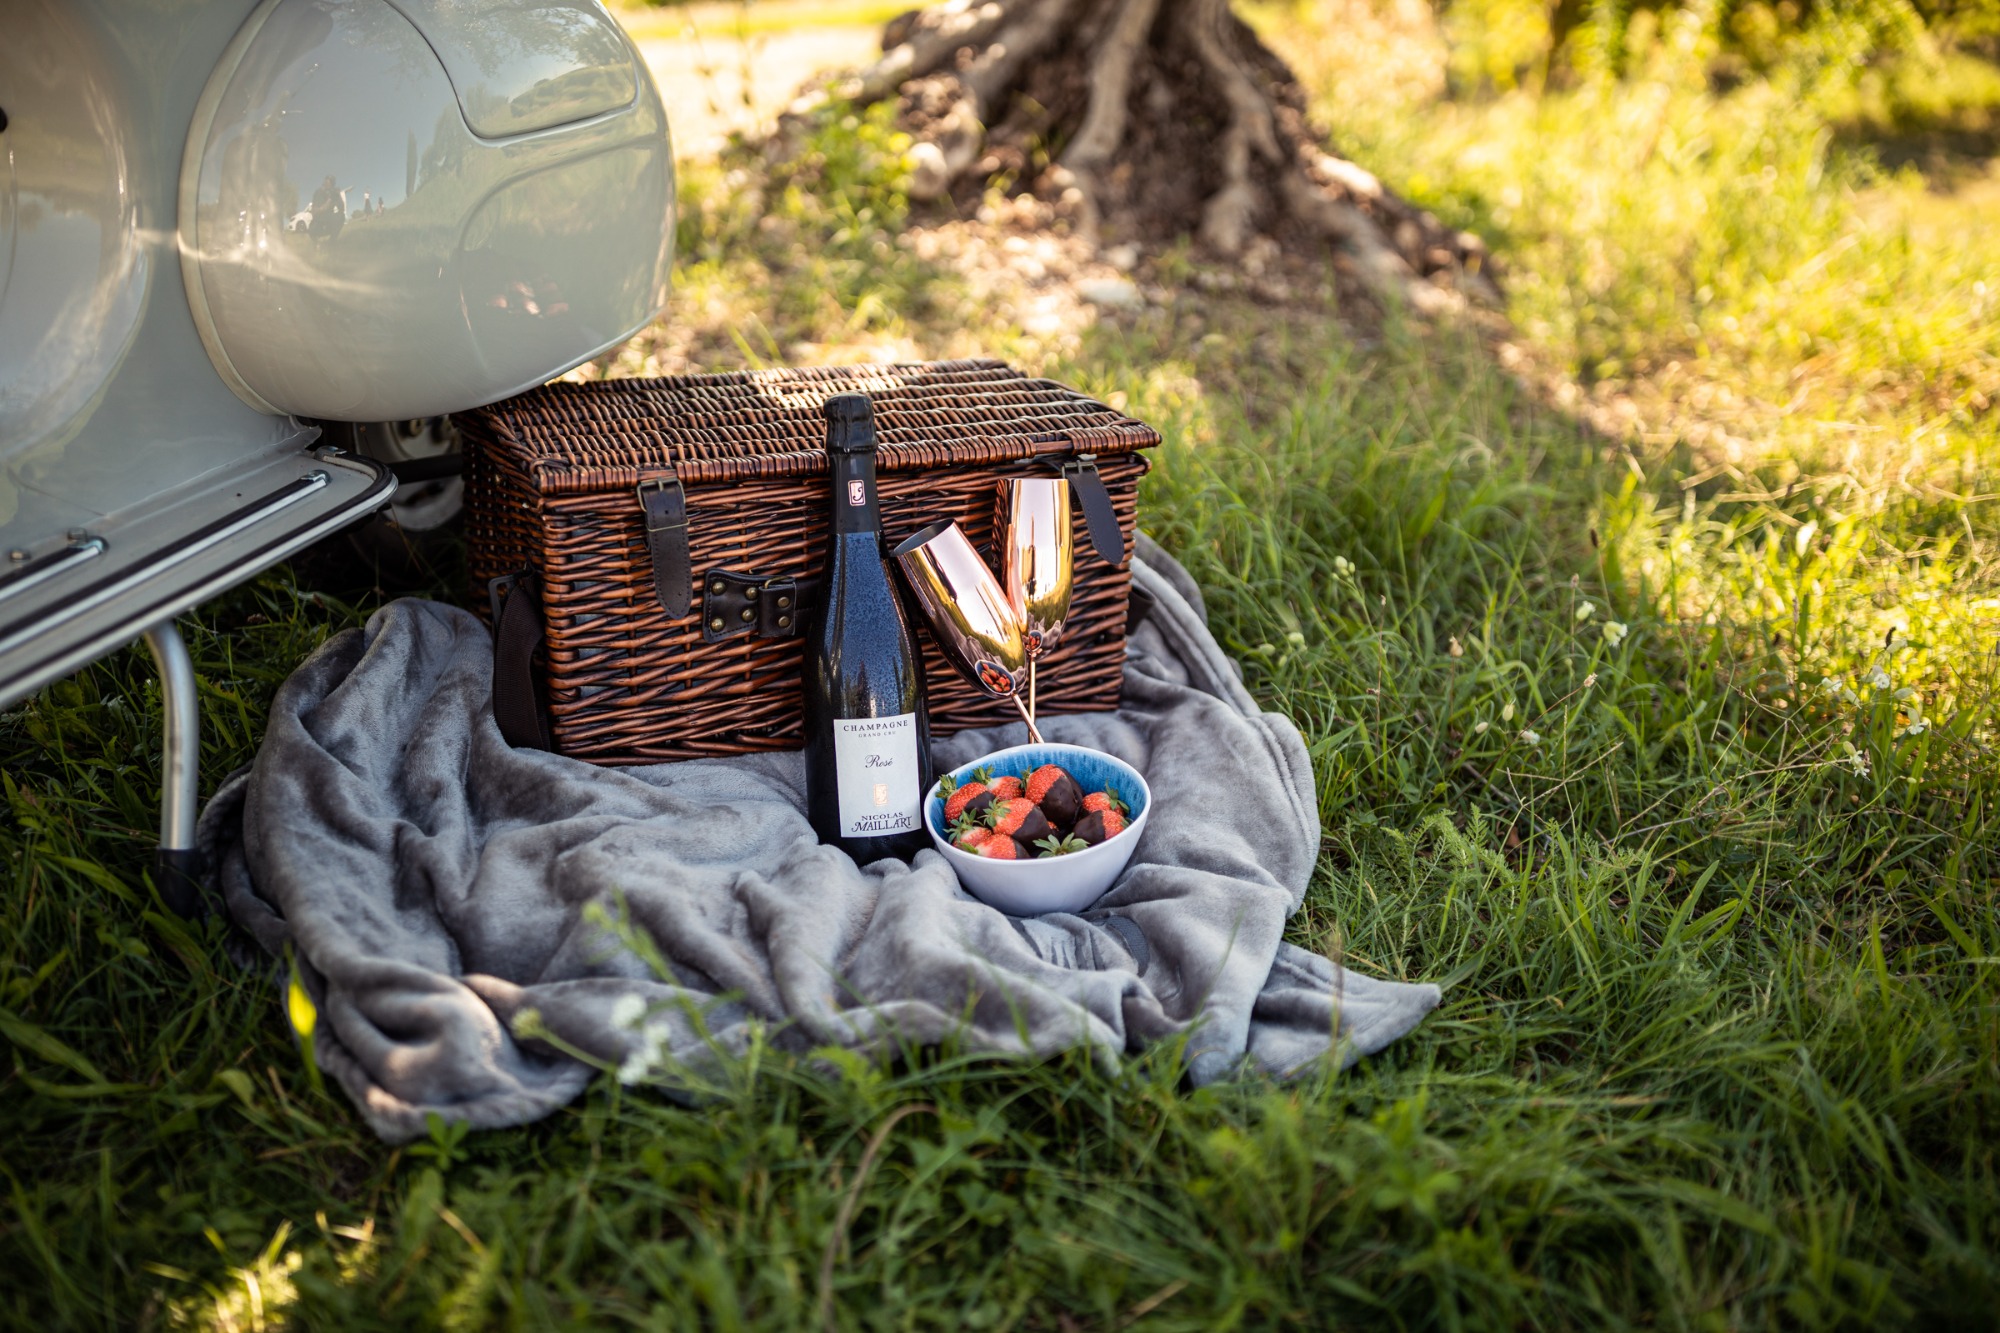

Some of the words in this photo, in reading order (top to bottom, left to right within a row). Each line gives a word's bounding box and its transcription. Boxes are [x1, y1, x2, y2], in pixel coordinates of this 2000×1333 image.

[843, 719, 908, 732] CHAMPAGNE
[865, 754, 893, 768] Rosé
[861, 811, 904, 821] NICOLAS
[851, 815, 913, 832] MAILLART
